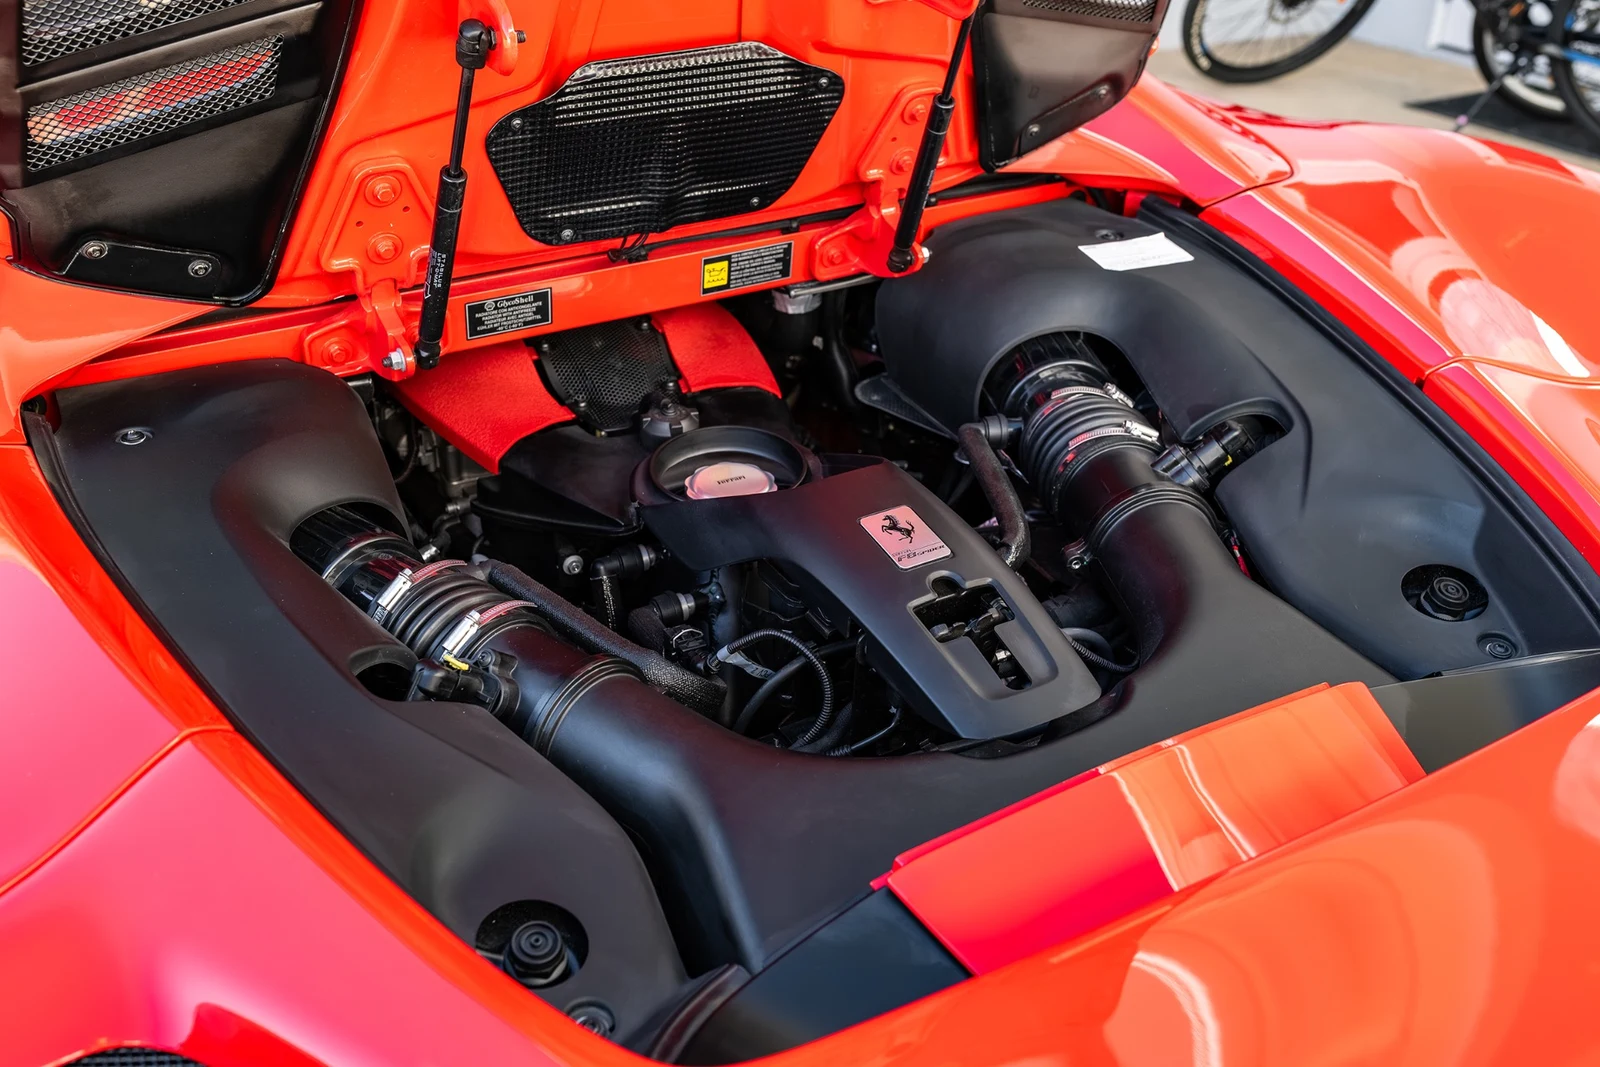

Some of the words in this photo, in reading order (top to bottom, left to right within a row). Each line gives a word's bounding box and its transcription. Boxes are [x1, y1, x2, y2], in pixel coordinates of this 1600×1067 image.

[437, 253, 446, 287] STABILUS
[497, 295, 533, 307] GlycoShell
[717, 475, 745, 485] Ferrari
